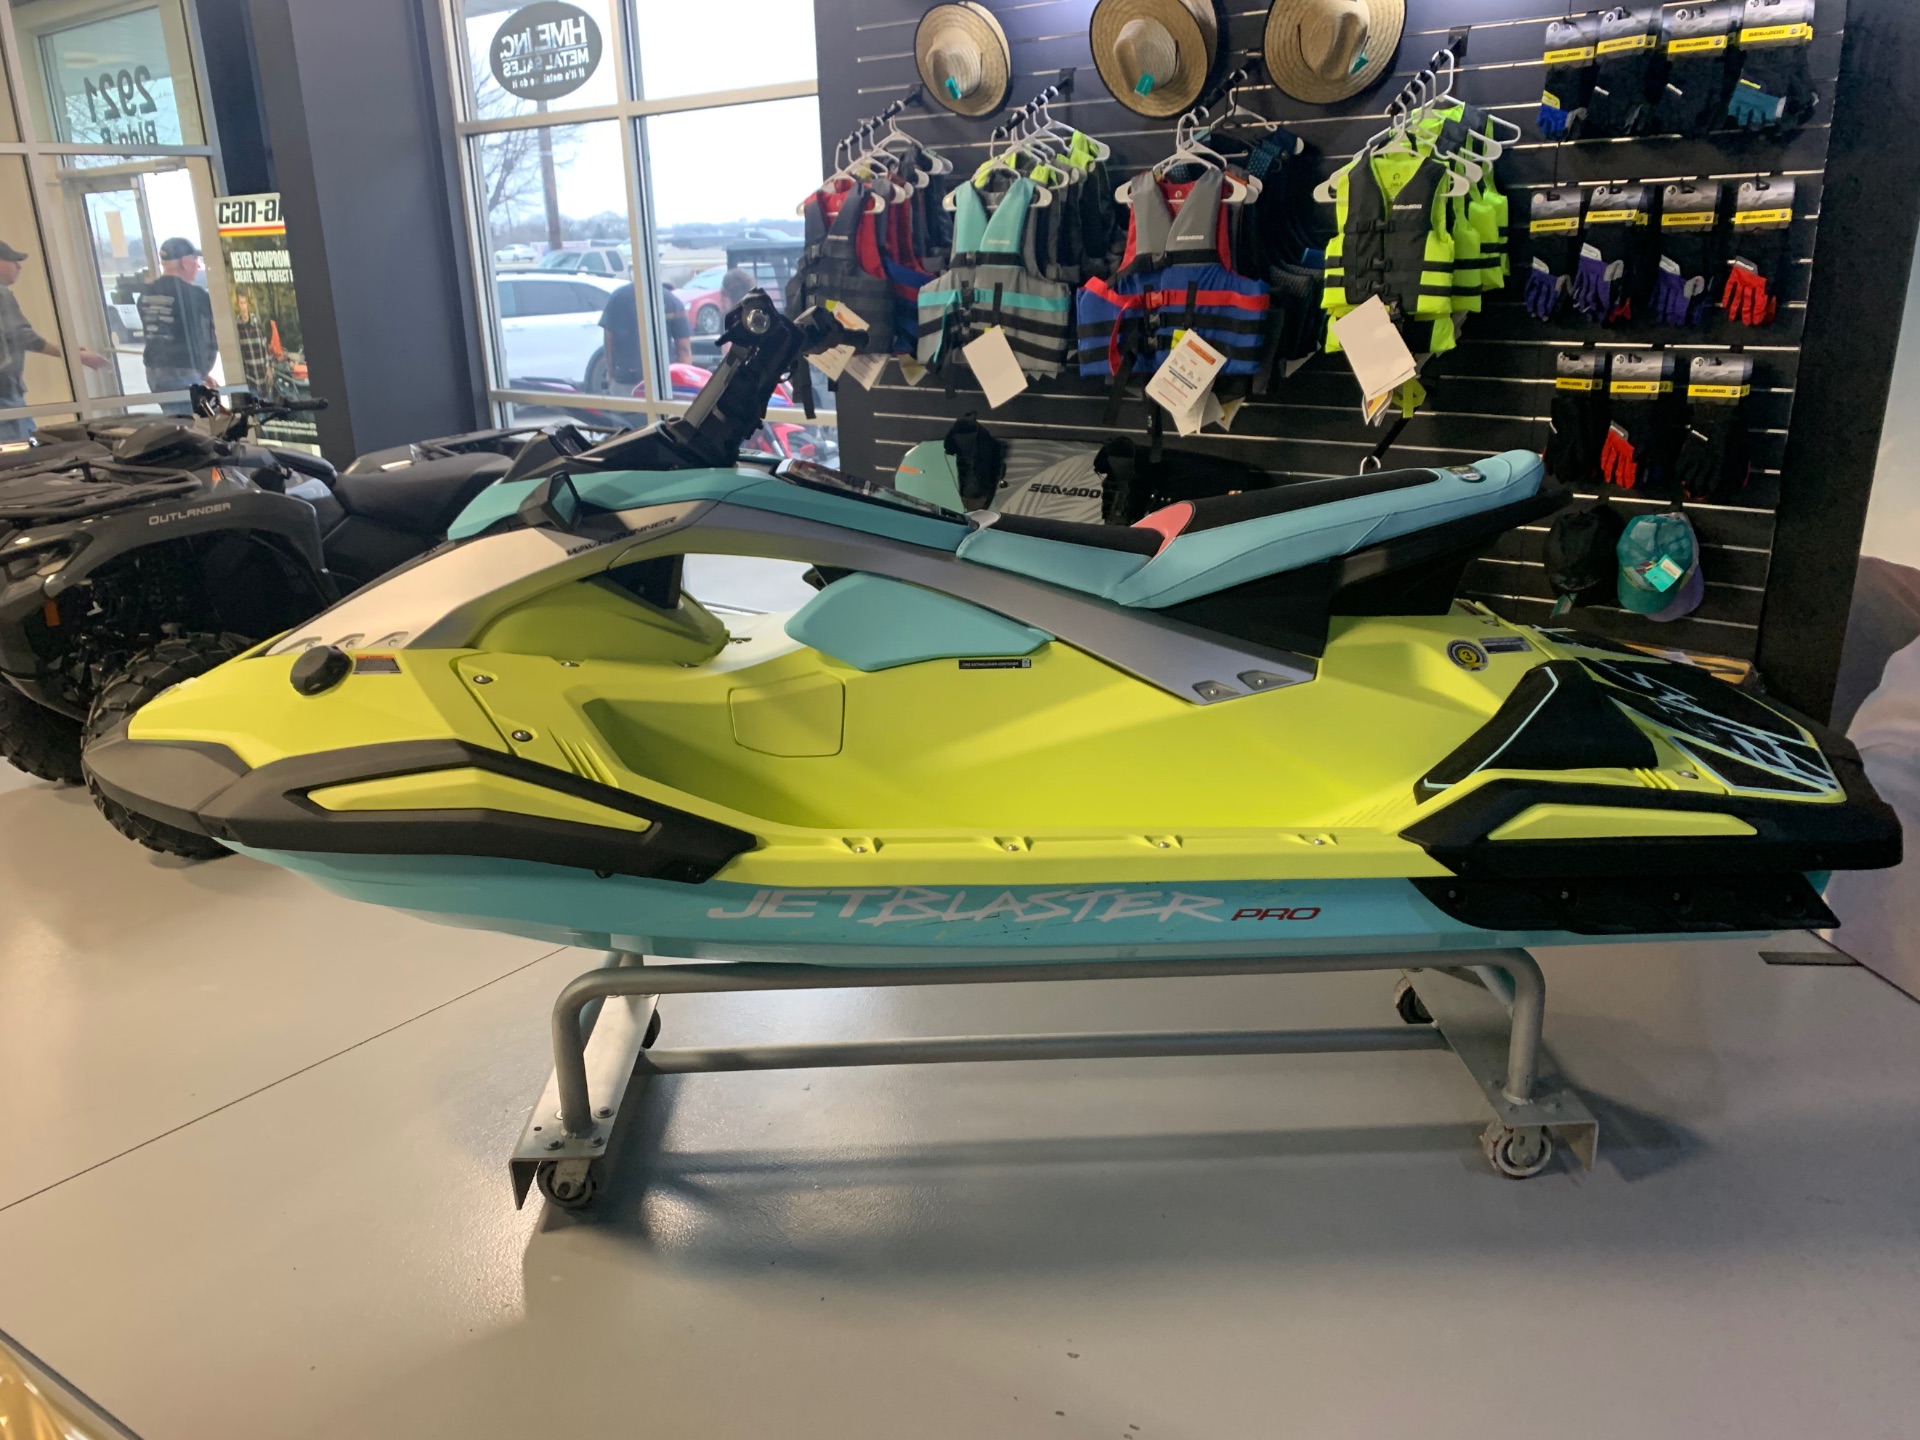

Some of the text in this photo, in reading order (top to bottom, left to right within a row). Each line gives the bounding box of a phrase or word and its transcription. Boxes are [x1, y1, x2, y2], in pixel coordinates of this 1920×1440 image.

[230, 251, 254, 269] NEVER
[233, 269, 253, 283] CREATE
[252, 269, 267, 283] YOUR
[266, 268, 289, 283] PERFECT
[148, 502, 232, 526] OUTLANDER
[1231, 907, 1321, 921] PRO
